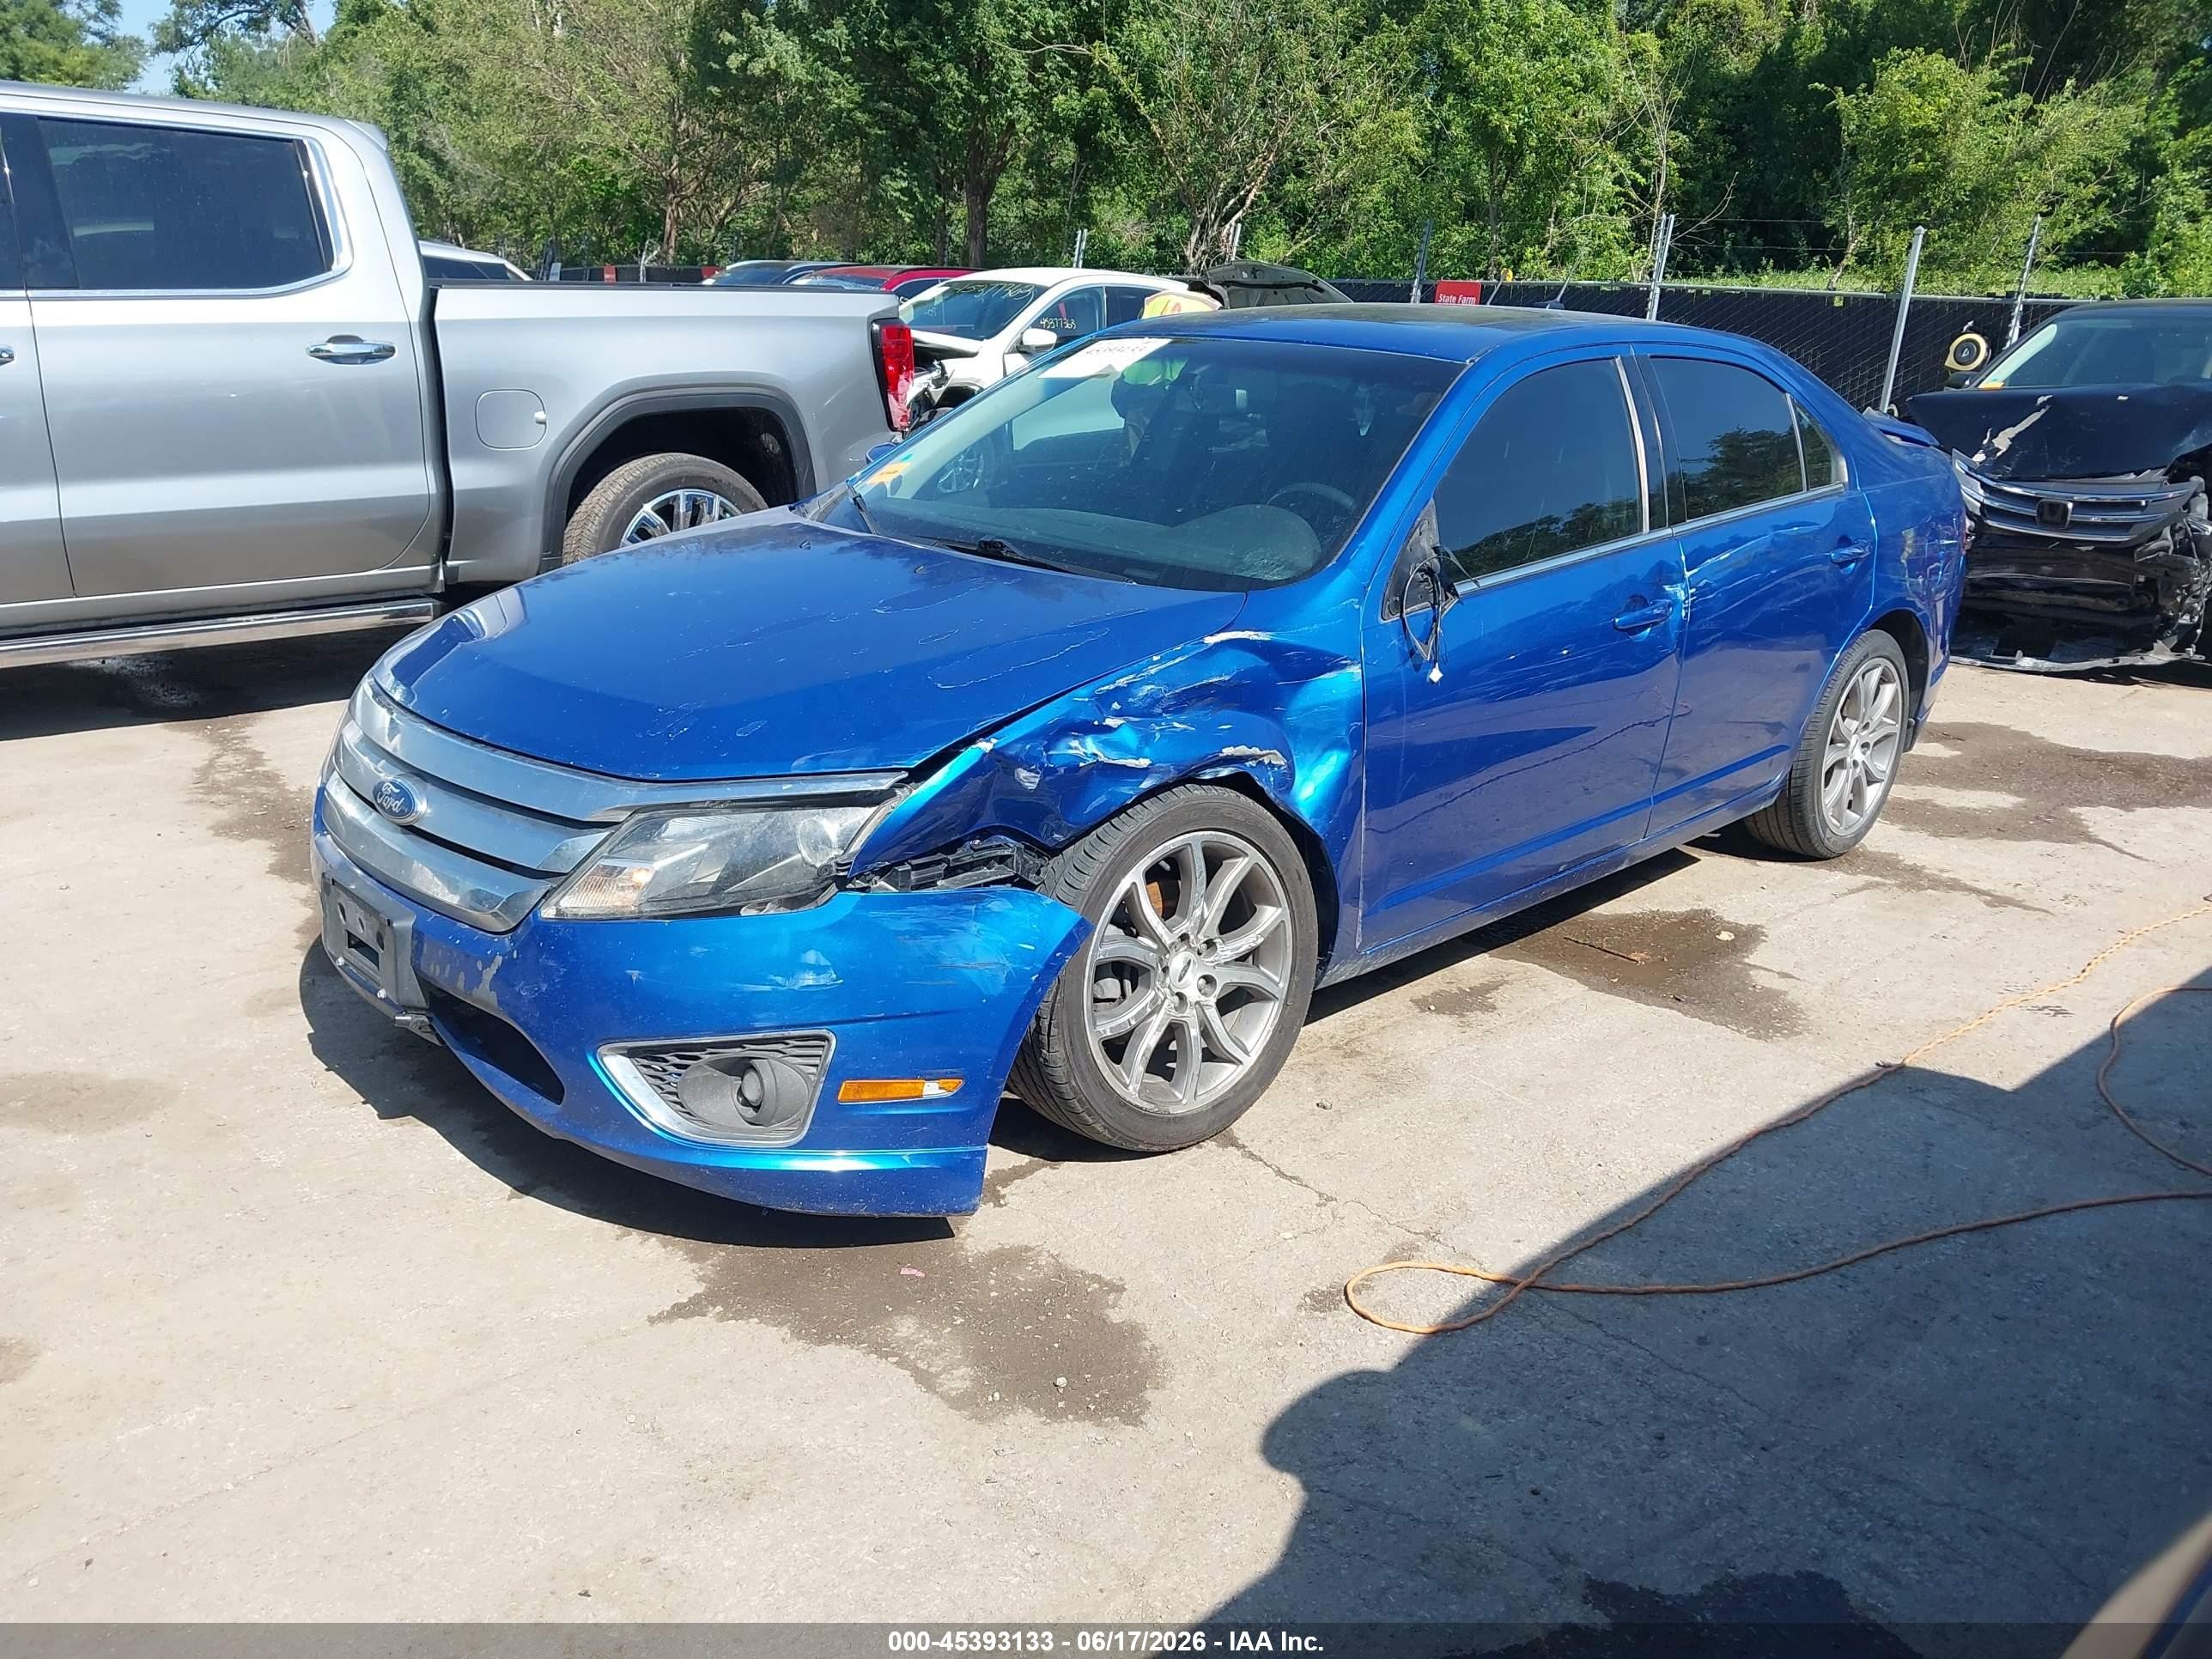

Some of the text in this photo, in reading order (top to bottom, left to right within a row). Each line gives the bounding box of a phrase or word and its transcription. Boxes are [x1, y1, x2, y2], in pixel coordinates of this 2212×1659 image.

[1437, 293, 1476, 305] State Farm
[1040, 317, 1077, 330] 45377363
[377, 782, 405, 813] Ford
